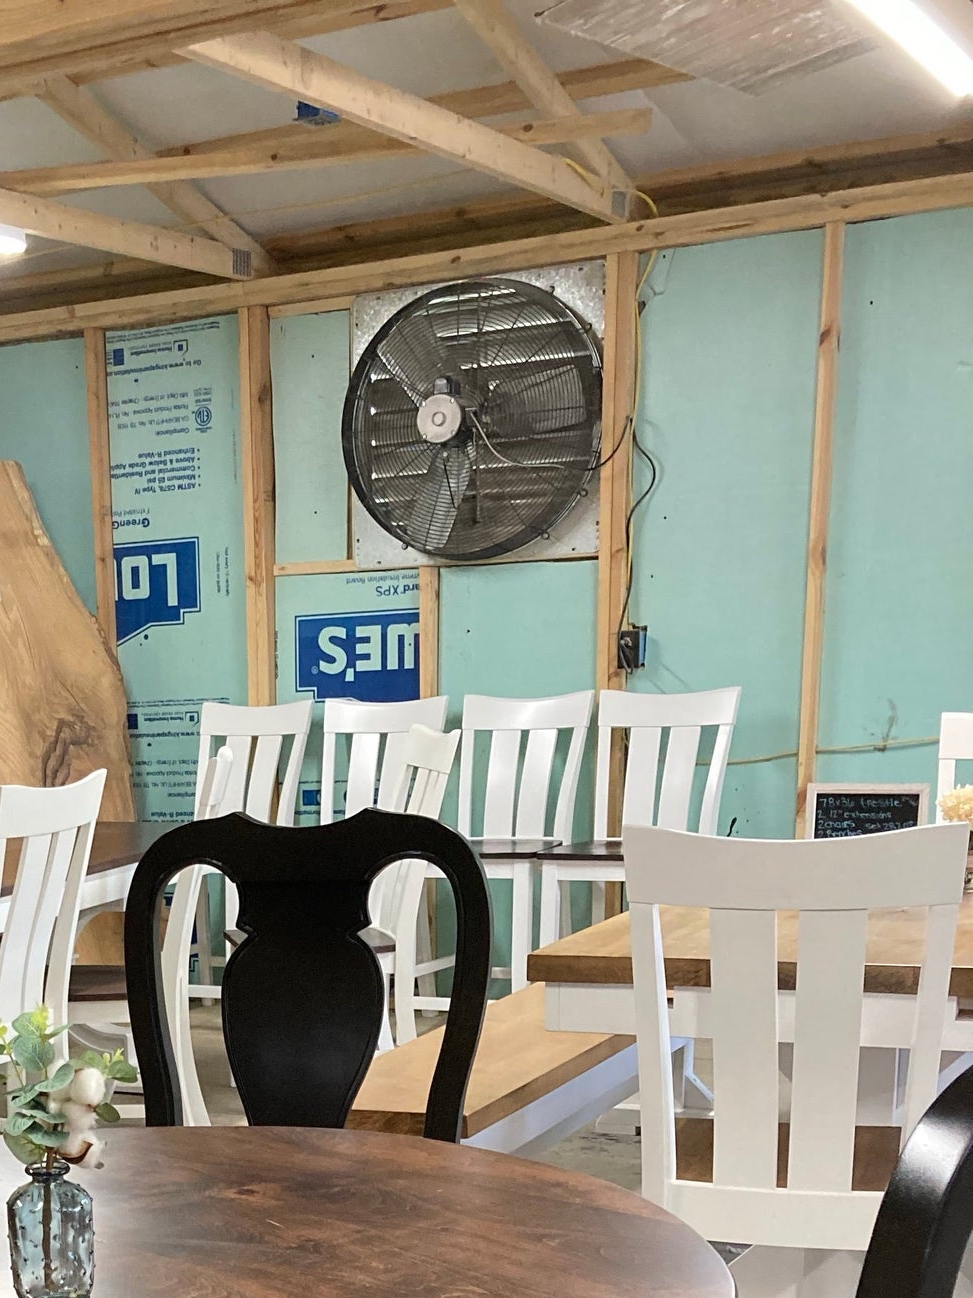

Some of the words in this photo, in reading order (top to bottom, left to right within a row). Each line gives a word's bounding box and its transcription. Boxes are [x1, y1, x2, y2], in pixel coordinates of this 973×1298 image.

[138, 451, 162, 459] R-Value
[164, 448, 195, 456] Enhanced
[175, 456, 195, 464] Above
[158, 465, 196, 475] Commercial
[167, 474, 196, 482] Minimum
[178, 482, 196, 490] ASTM
[114, 553, 178, 607] LO
[375, 585, 399, 596] XPS
